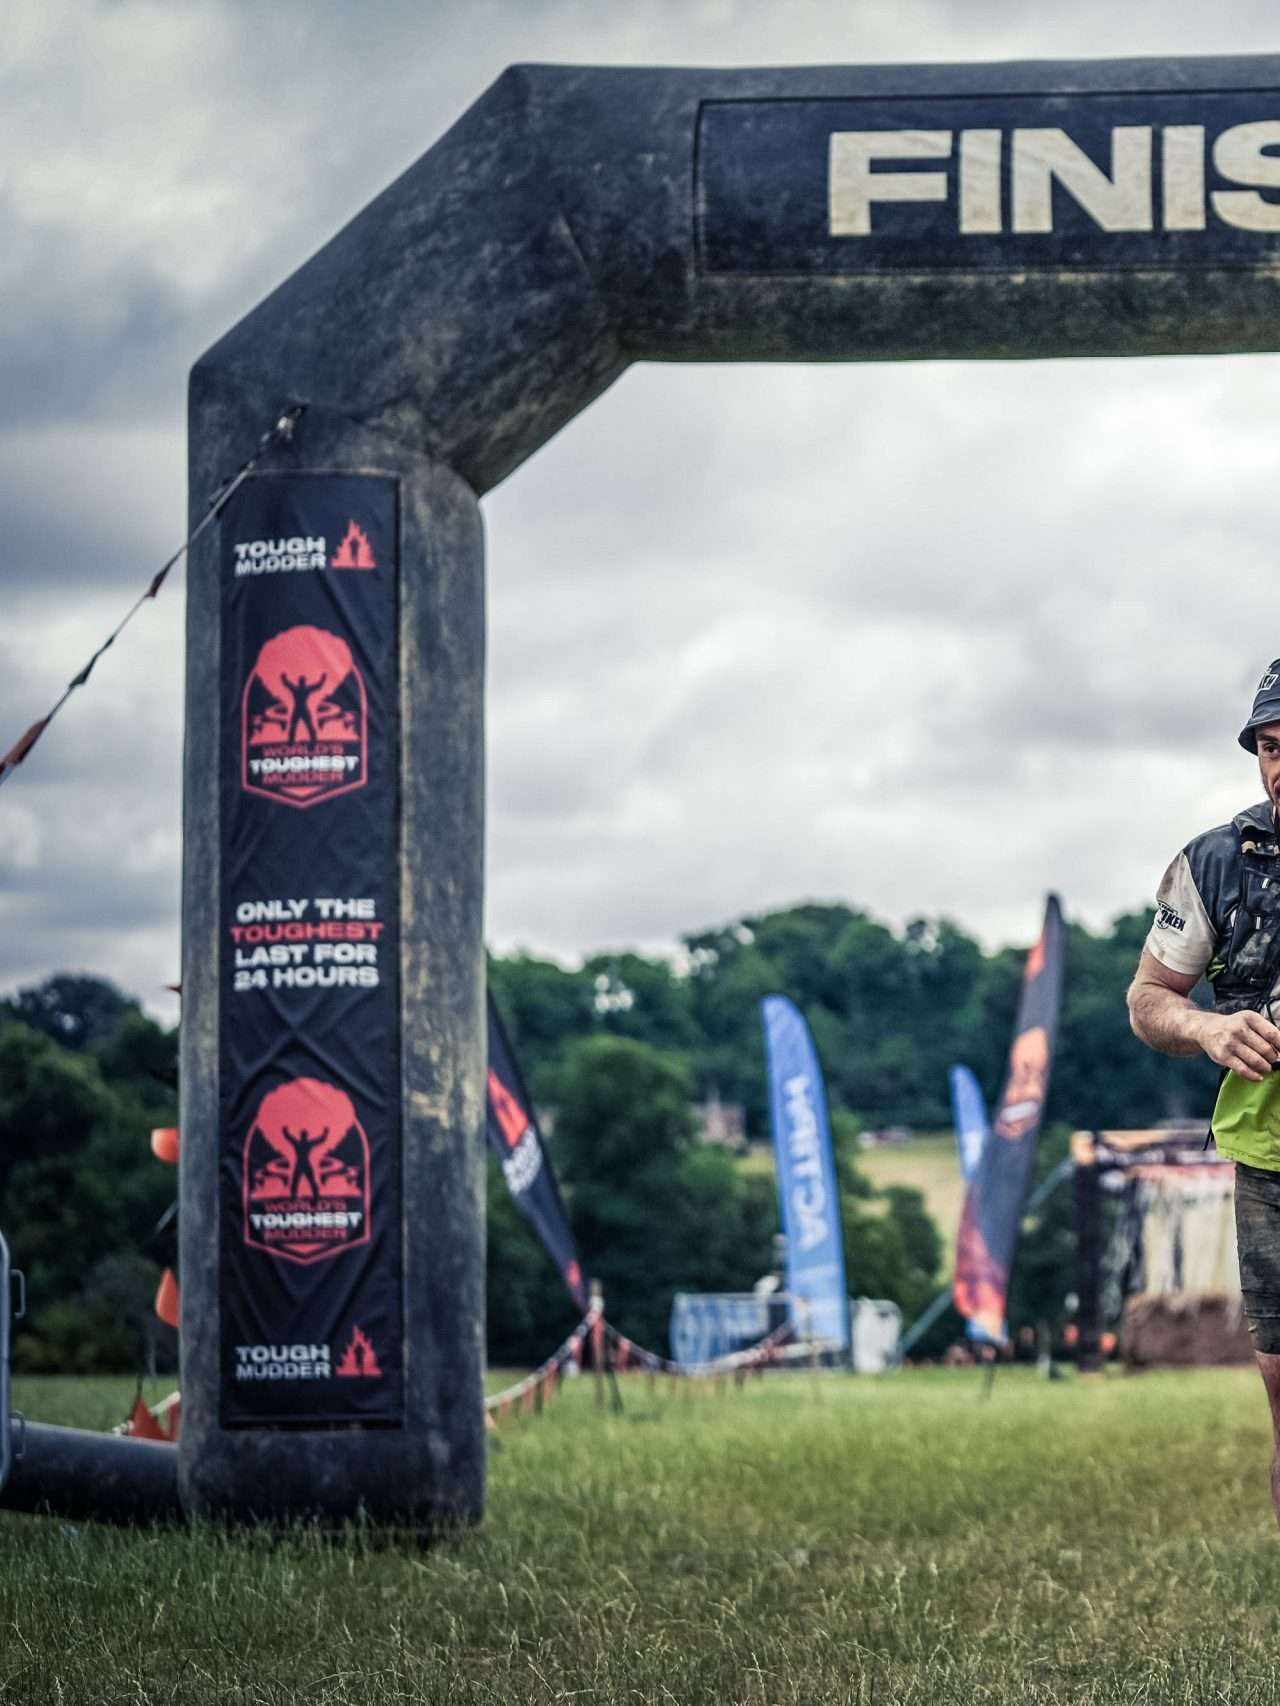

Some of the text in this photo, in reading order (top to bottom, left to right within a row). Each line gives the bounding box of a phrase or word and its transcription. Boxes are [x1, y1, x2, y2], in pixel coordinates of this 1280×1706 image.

[234, 536, 326, 559] TOUGH
[235, 553, 327, 577] MUDDER
[249, 755, 360, 775] TOUGHEST
[236, 898, 376, 923] ONLY THE
[229, 921, 385, 944] TOUGHEST
[235, 942, 377, 968] LAST FOR
[233, 965, 380, 992] 24 HOURS
[250, 1211, 362, 1230] TOUGHEST
[235, 1343, 331, 1363] TOUGH
[235, 1361, 331, 1380] MUDDER
